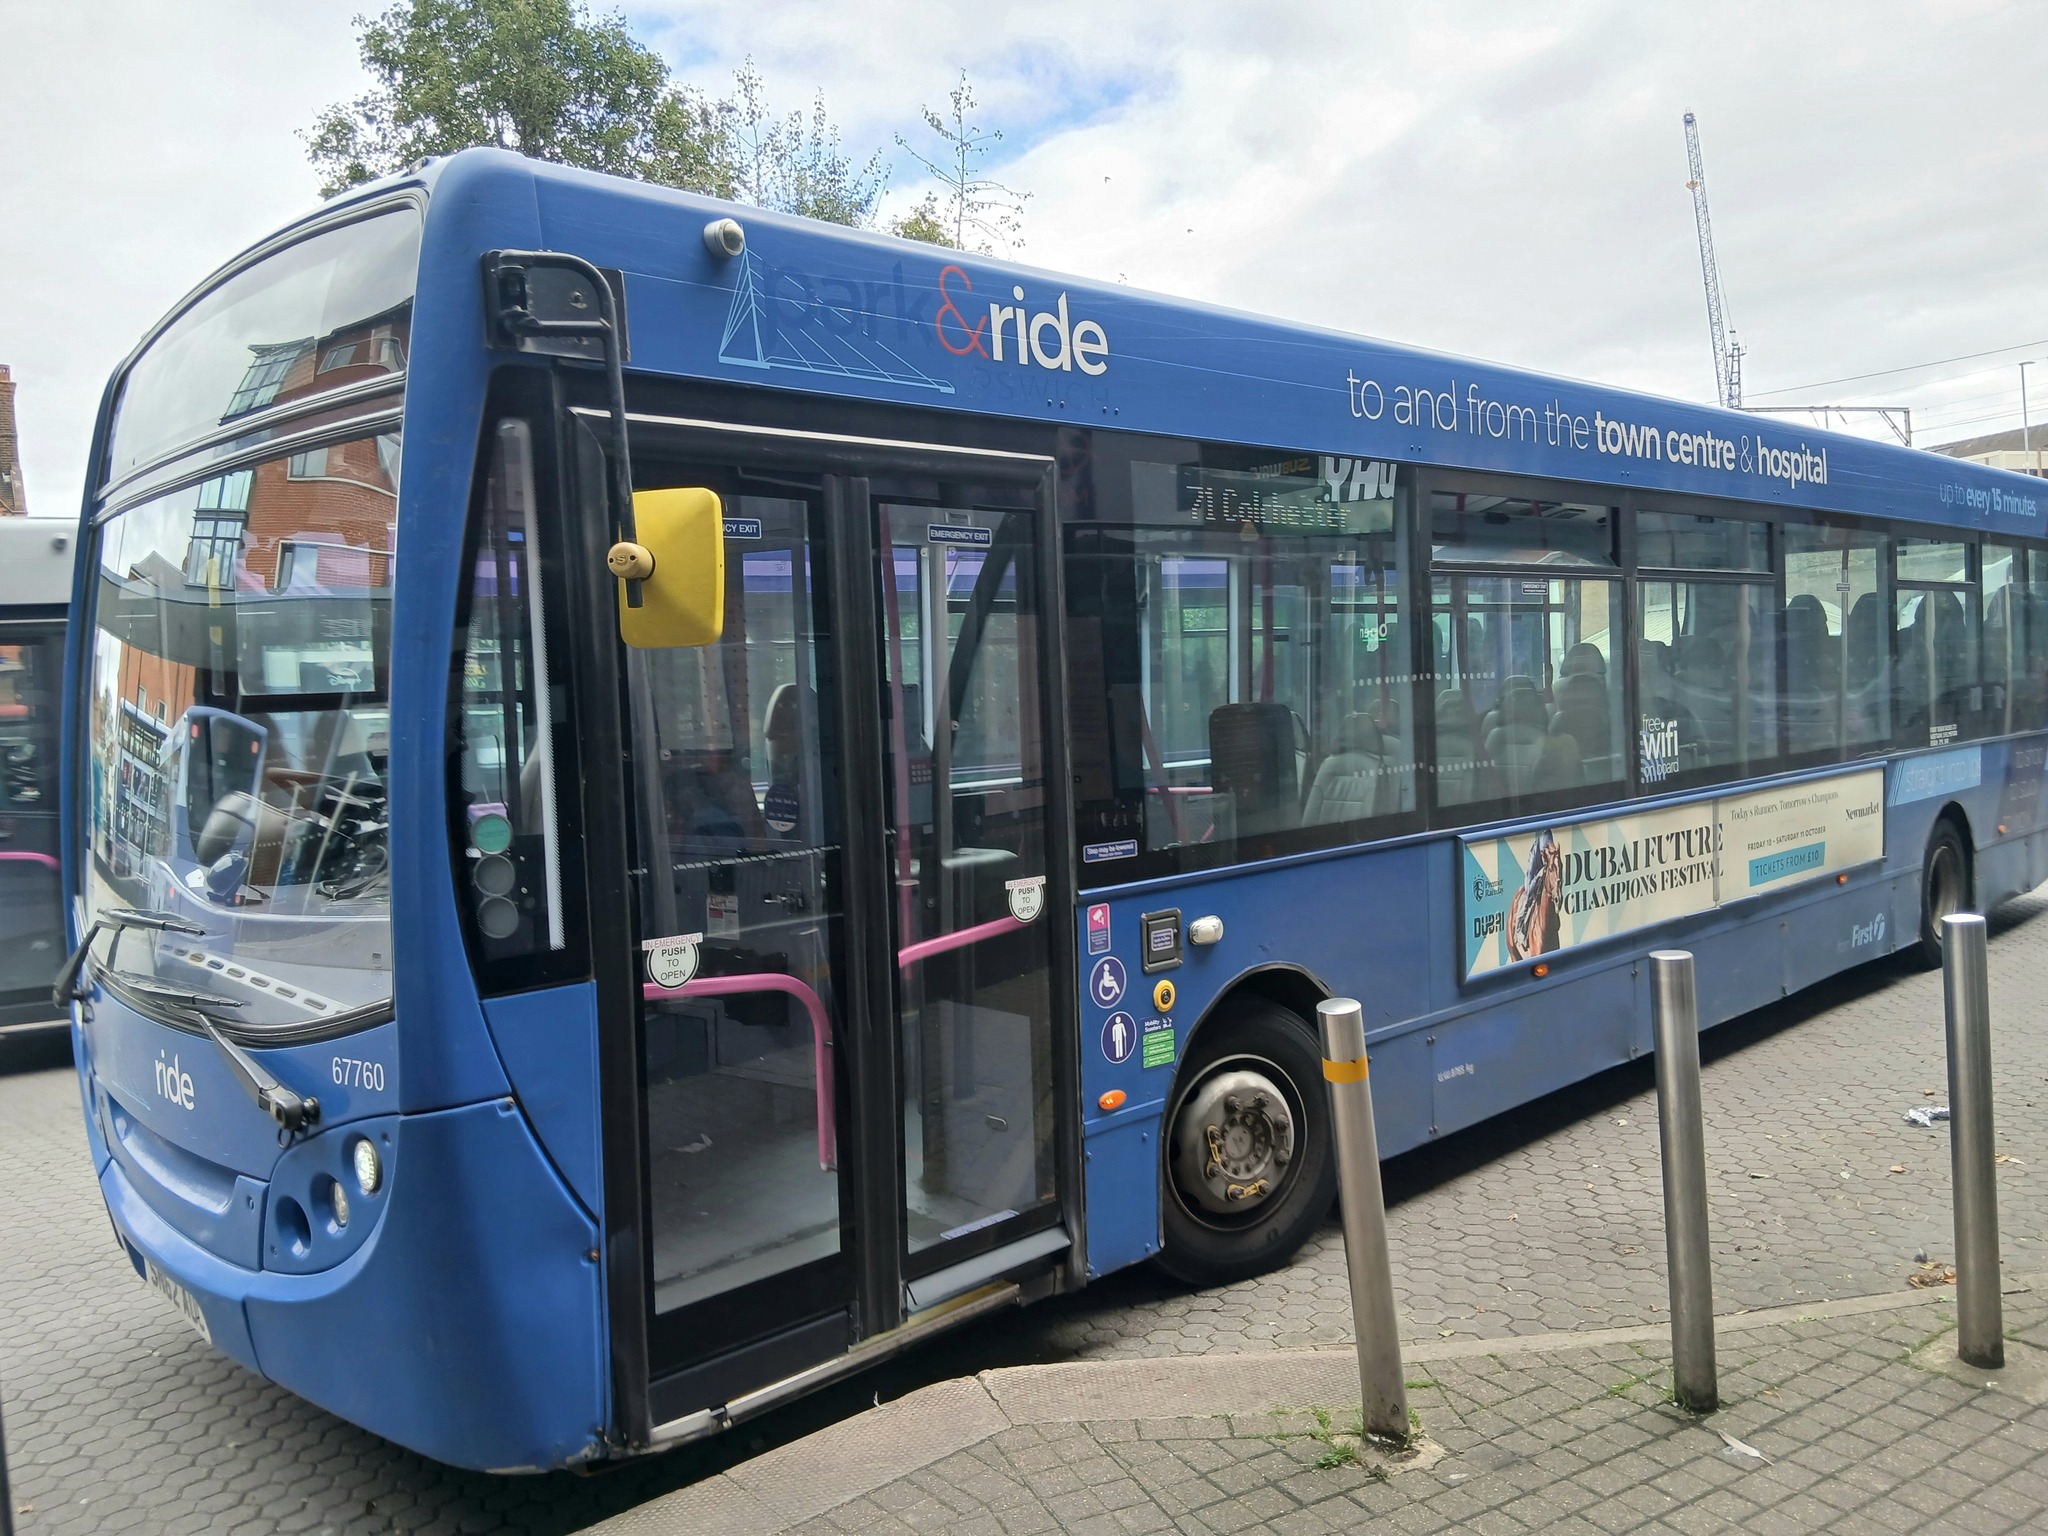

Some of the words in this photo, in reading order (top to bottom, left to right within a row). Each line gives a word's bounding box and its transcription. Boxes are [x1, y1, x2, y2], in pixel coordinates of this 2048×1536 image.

[1347, 368, 1384, 420] to
[1394, 379, 1457, 432] and
[1467, 383, 1537, 443] from
[1545, 398, 1589, 450] the
[1595, 410, 1661, 461] town
[1666, 430, 1735, 471] centre
[1740, 434, 1754, 474] &
[1756, 434, 1828, 490] hospital
[1186, 485, 1217, 521] 71
[1223, 488, 1352, 529] Colchester
[1939, 483, 1953, 509] up
[1954, 482, 1965, 506] to
[1966, 487, 1991, 516] every
[1991, 487, 2001, 511] 15
[2003, 489, 2037, 517] minutes
[739, 524, 758, 534] EXIT
[930, 529, 974, 540] EMERGENCY
[974, 532, 989, 541] EXIT
[1642, 713, 1660, 732] free
[1642, 720, 1679, 760] wifi
[1656, 757, 1680, 776] board
[1811, 790, 1839, 806] Champions
[1845, 802, 1880, 821] Newmarket
[1747, 840, 1766, 851] FRIDAY
[1766, 838, 1772, 847] 10
[1776, 832, 1799, 844] SATURDAY
[1805, 826, 1826, 837] OCTOBER
[1564, 841, 1639, 887] DUBAI
[1645, 823, 1723, 868] FUTURE
[1754, 858, 1784, 877] TICKETS
[1785, 854, 1806, 868] FROM
[1806, 849, 1819, 863] £10
[1013, 877, 1045, 888] EMERGENCY
[1018, 886, 1035, 896] PUSH
[1564, 874, 1658, 915] CHAMPIONS
[1661, 858, 1724, 892] FESTIVAL
[1022, 896, 1031, 904] TO
[1017, 905, 1035, 915] OPEN
[1473, 911, 1505, 939] DUBAI
[1852, 921, 1874, 948] First
[645, 941, 653, 949] IN
[654, 934, 701, 948] EMERGENCY
[661, 946, 686, 957] PUSH
[666, 958, 679, 968] TO
[660, 969, 686, 981] OPEN
[155, 1048, 195, 1111] ride
[331, 1056, 385, 1092] 67760
